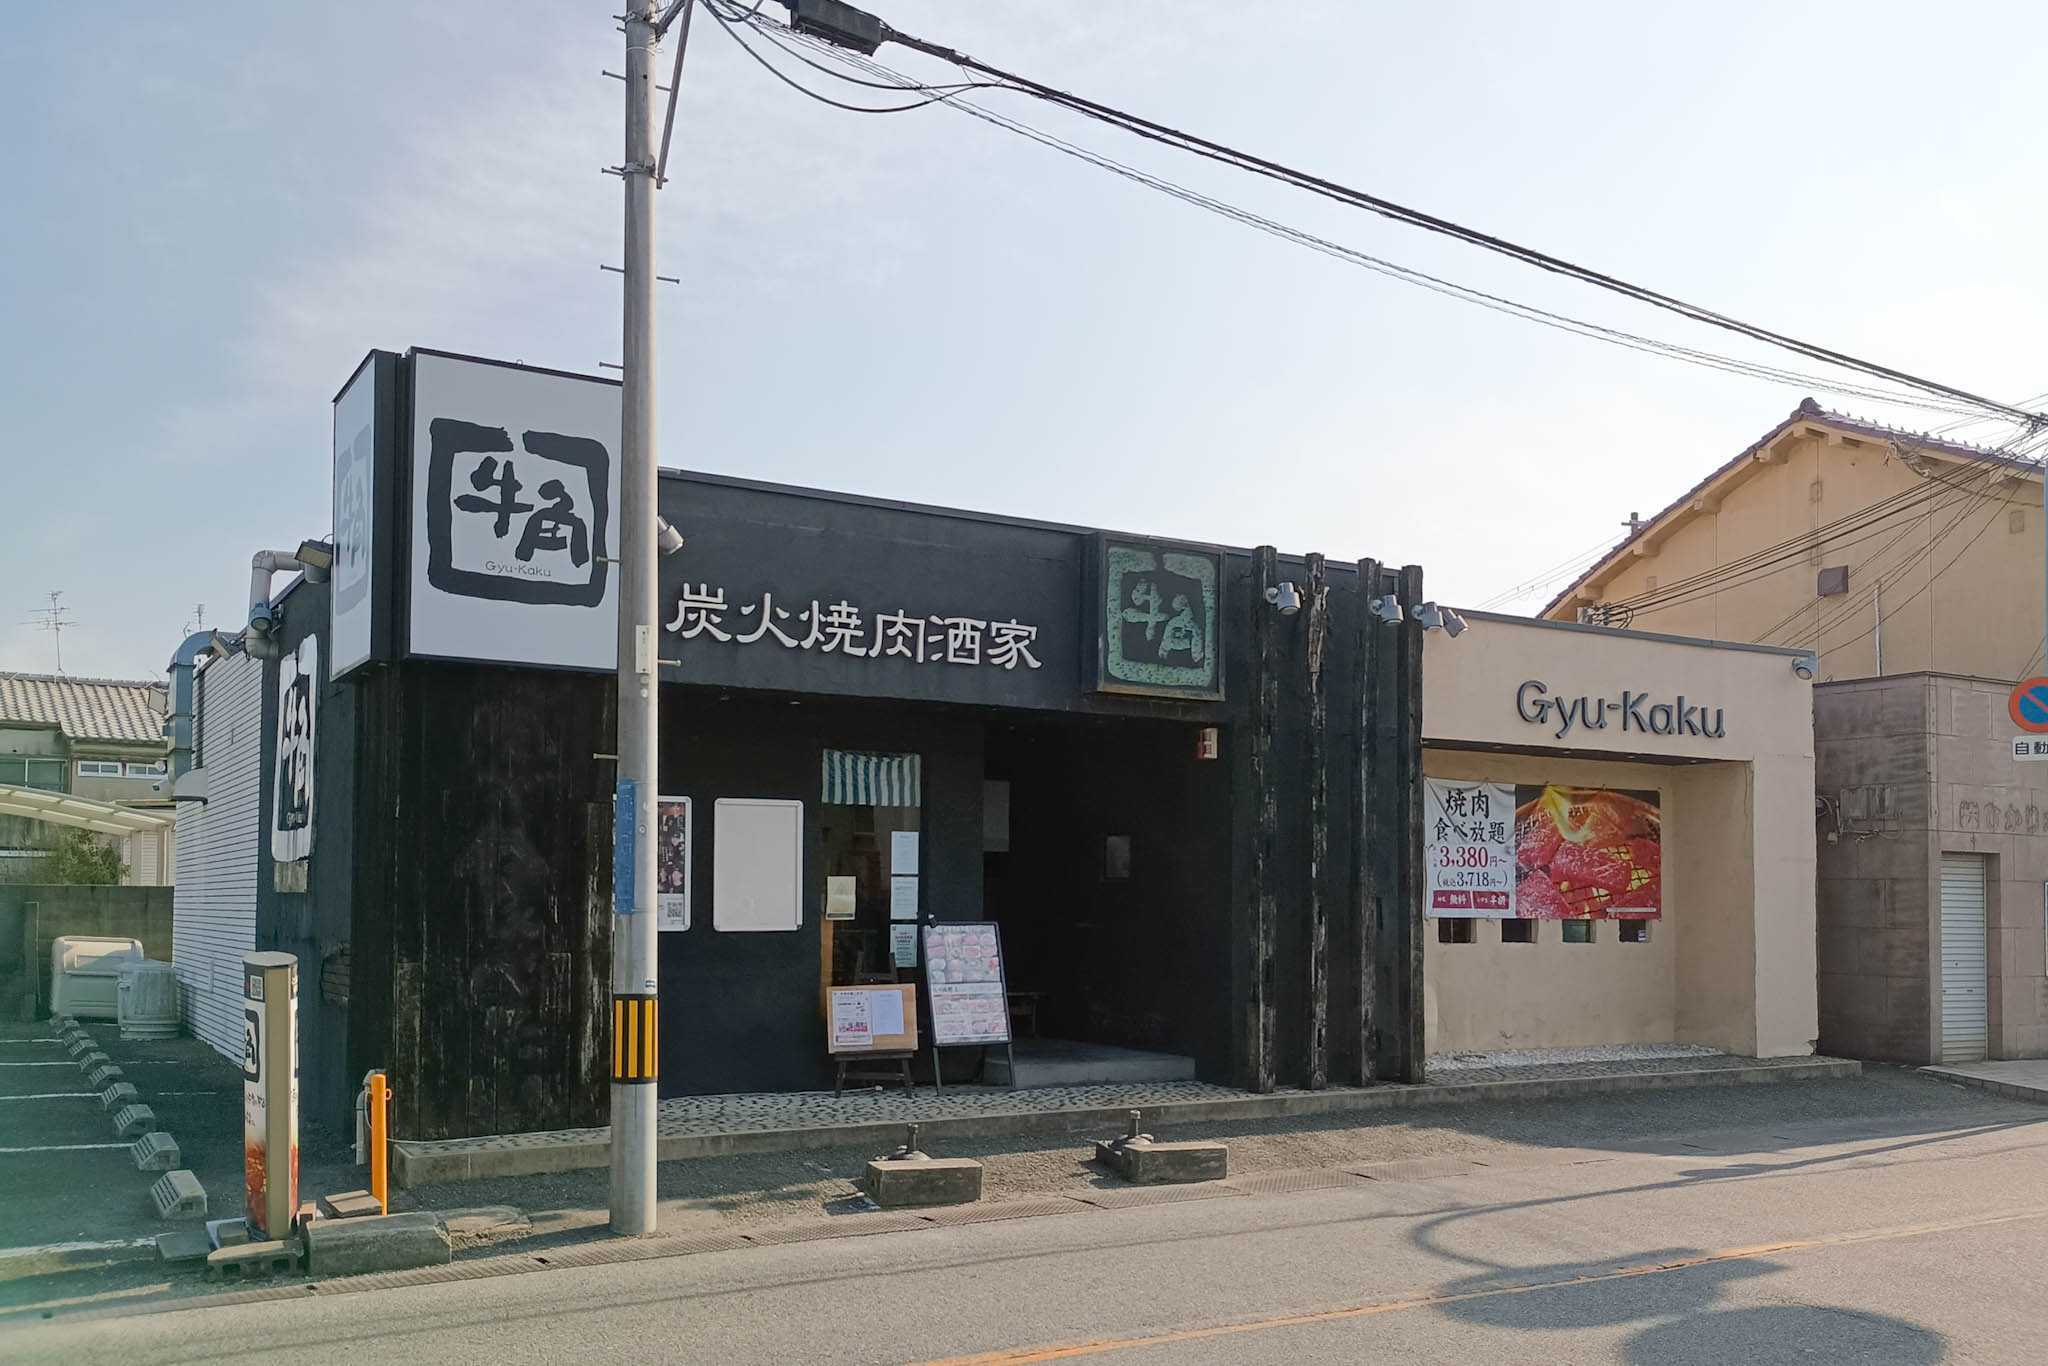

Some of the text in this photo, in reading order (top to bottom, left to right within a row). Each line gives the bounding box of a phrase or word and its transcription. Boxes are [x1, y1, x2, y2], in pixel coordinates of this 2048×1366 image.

[453, 456, 590, 568] 牛角
[485, 560, 552, 577] Gyu-Kaku
[665, 582, 1043, 670] 炭火焼肉酒家
[1122, 578, 1205, 662] 牛角
[1516, 680, 1726, 739] Gyu-Kaku
[282, 684, 309, 809] 牛角
[1433, 816, 1506, 845] 食べ放題
[1445, 788, 1490, 818] 焼肉
